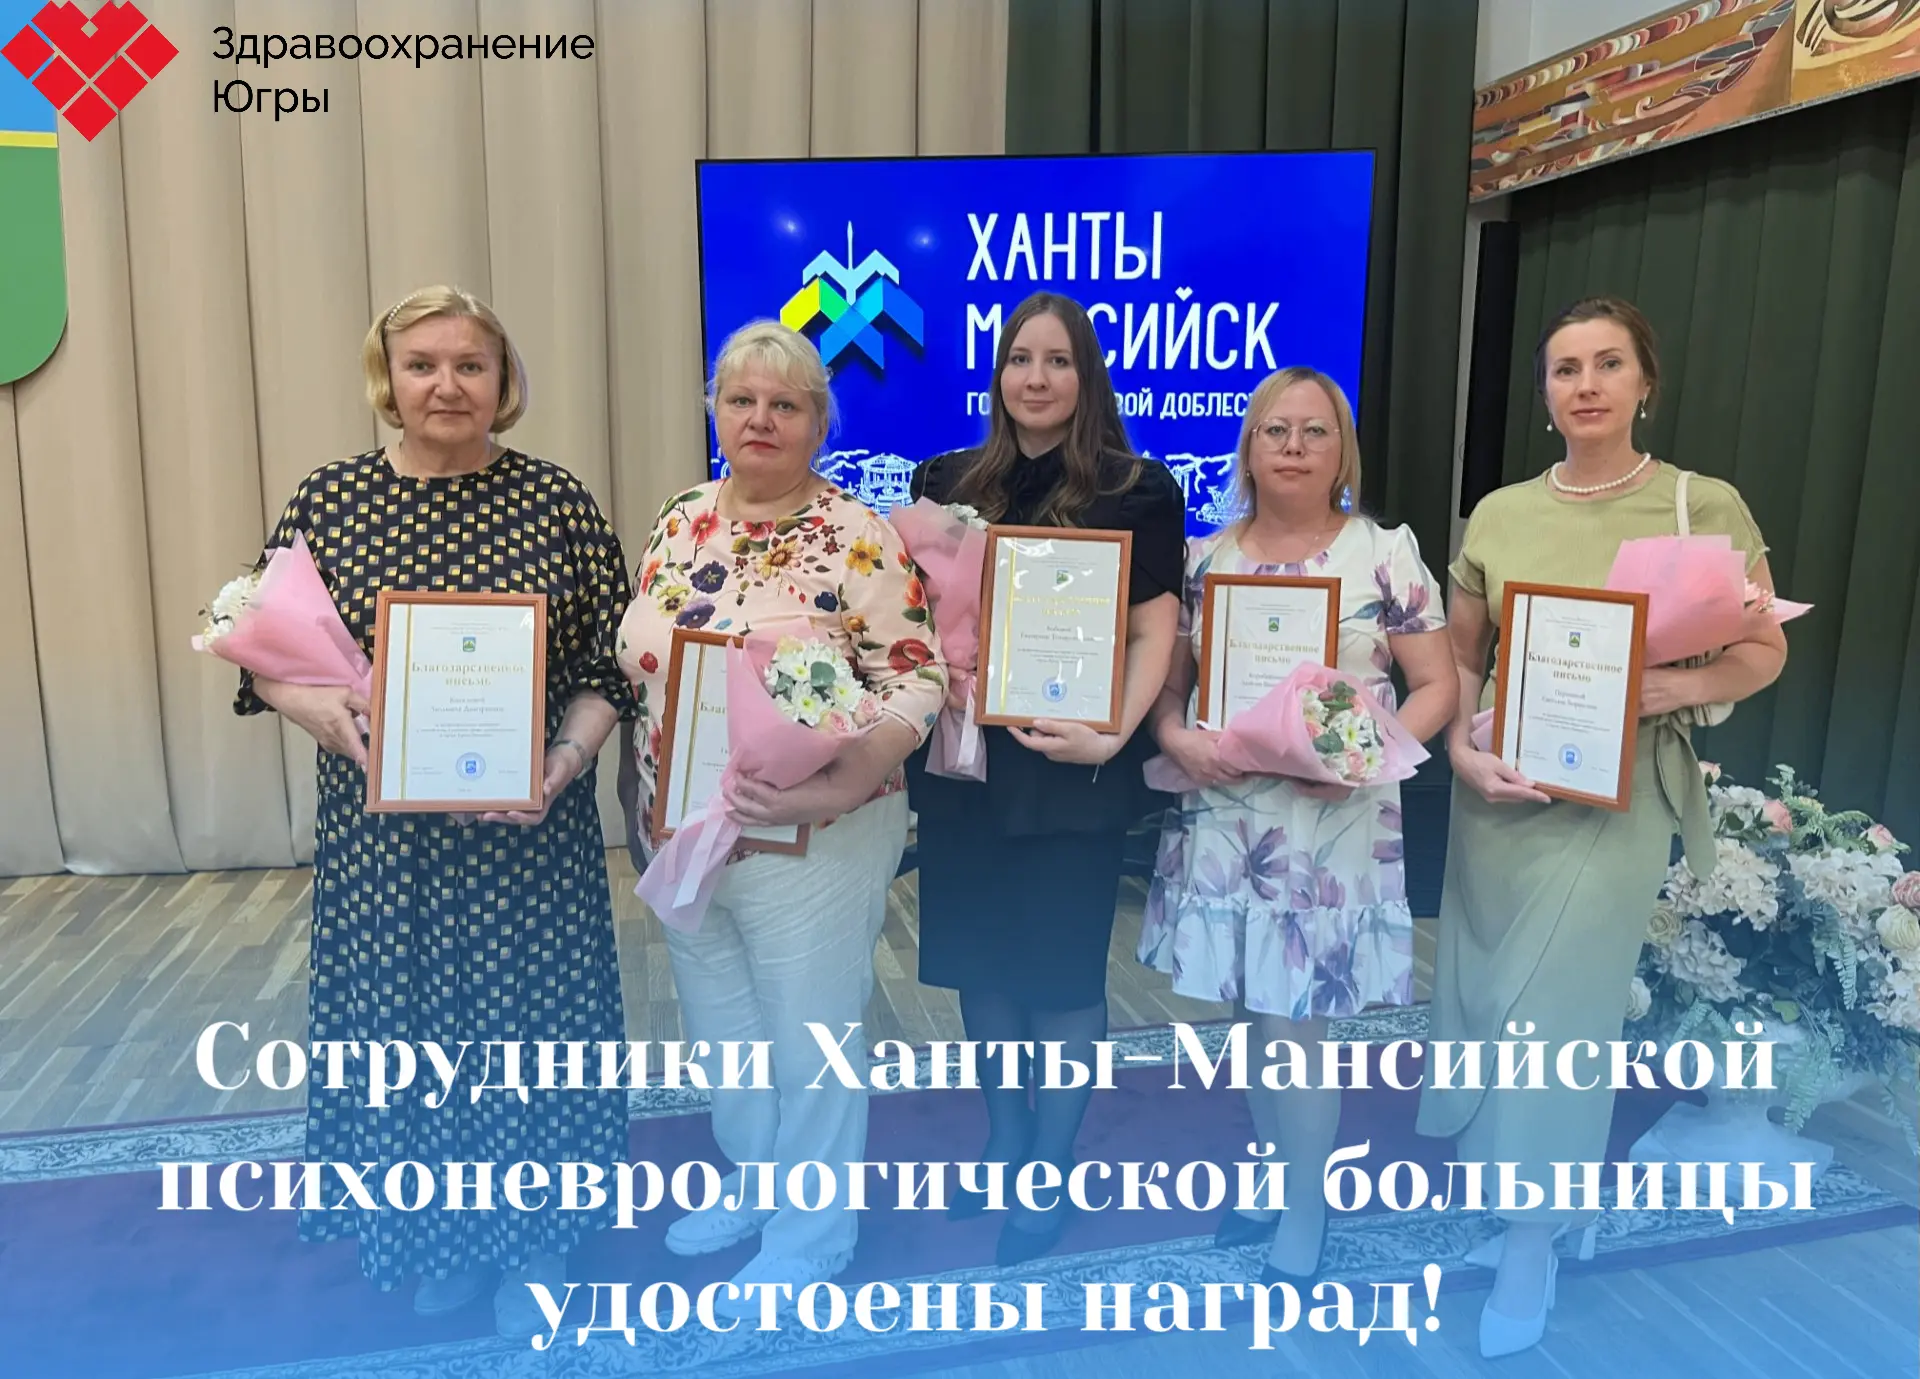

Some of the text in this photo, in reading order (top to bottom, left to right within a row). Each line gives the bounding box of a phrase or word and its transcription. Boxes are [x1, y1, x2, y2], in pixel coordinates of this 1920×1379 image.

[966, 211, 1162, 281] ХАНТЫ
[966, 287, 1280, 370] МСИЙСК
[1159, 391, 1253, 420] ДОБЛЕС
